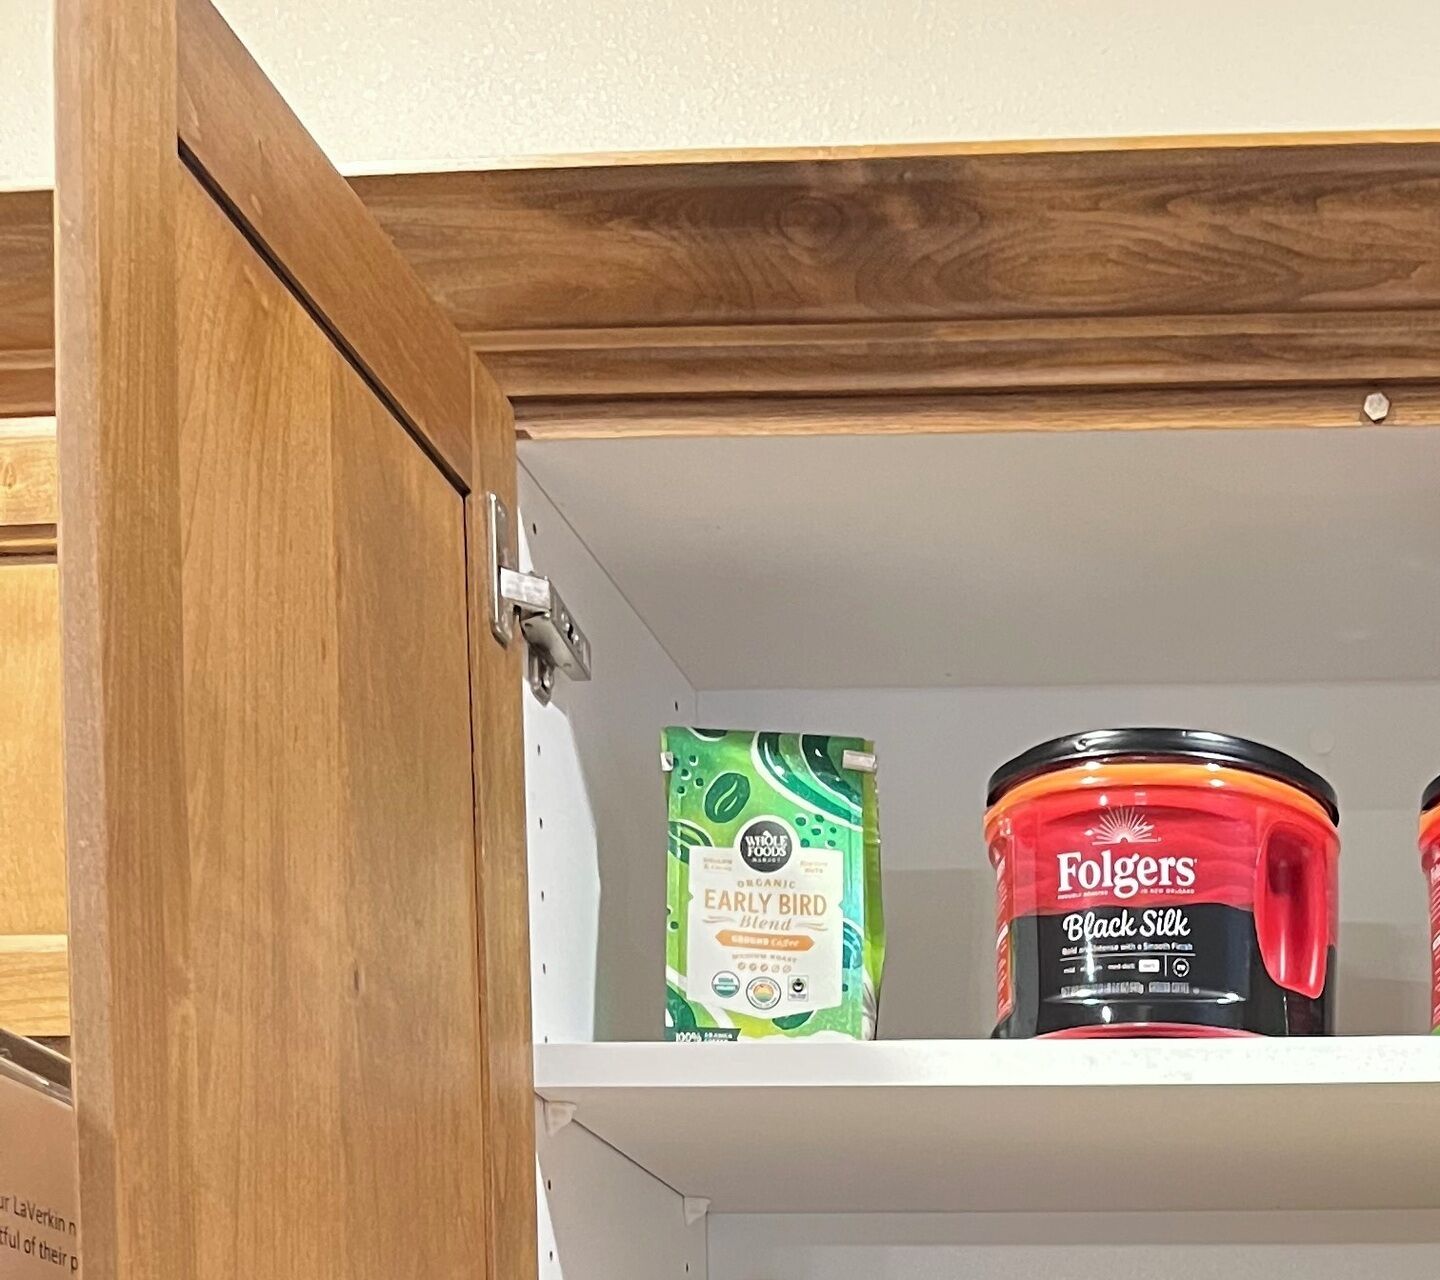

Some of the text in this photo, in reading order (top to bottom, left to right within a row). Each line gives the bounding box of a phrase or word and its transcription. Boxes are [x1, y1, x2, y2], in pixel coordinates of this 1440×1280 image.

[745, 834, 789, 848] WHOLE
[747, 846, 787, 857] FOODS
[737, 879, 796, 889] ORGANIC
[1057, 850, 1196, 898] Folgers
[704, 888, 827, 916] EARLY BIRD
[739, 915, 793, 931] Blend
[1062, 908, 1191, 941] Black Silk
[13, 1195, 65, 1232] LaVerkin
[24, 1236, 36, 1256] of
[39, 1241, 67, 1267] their
